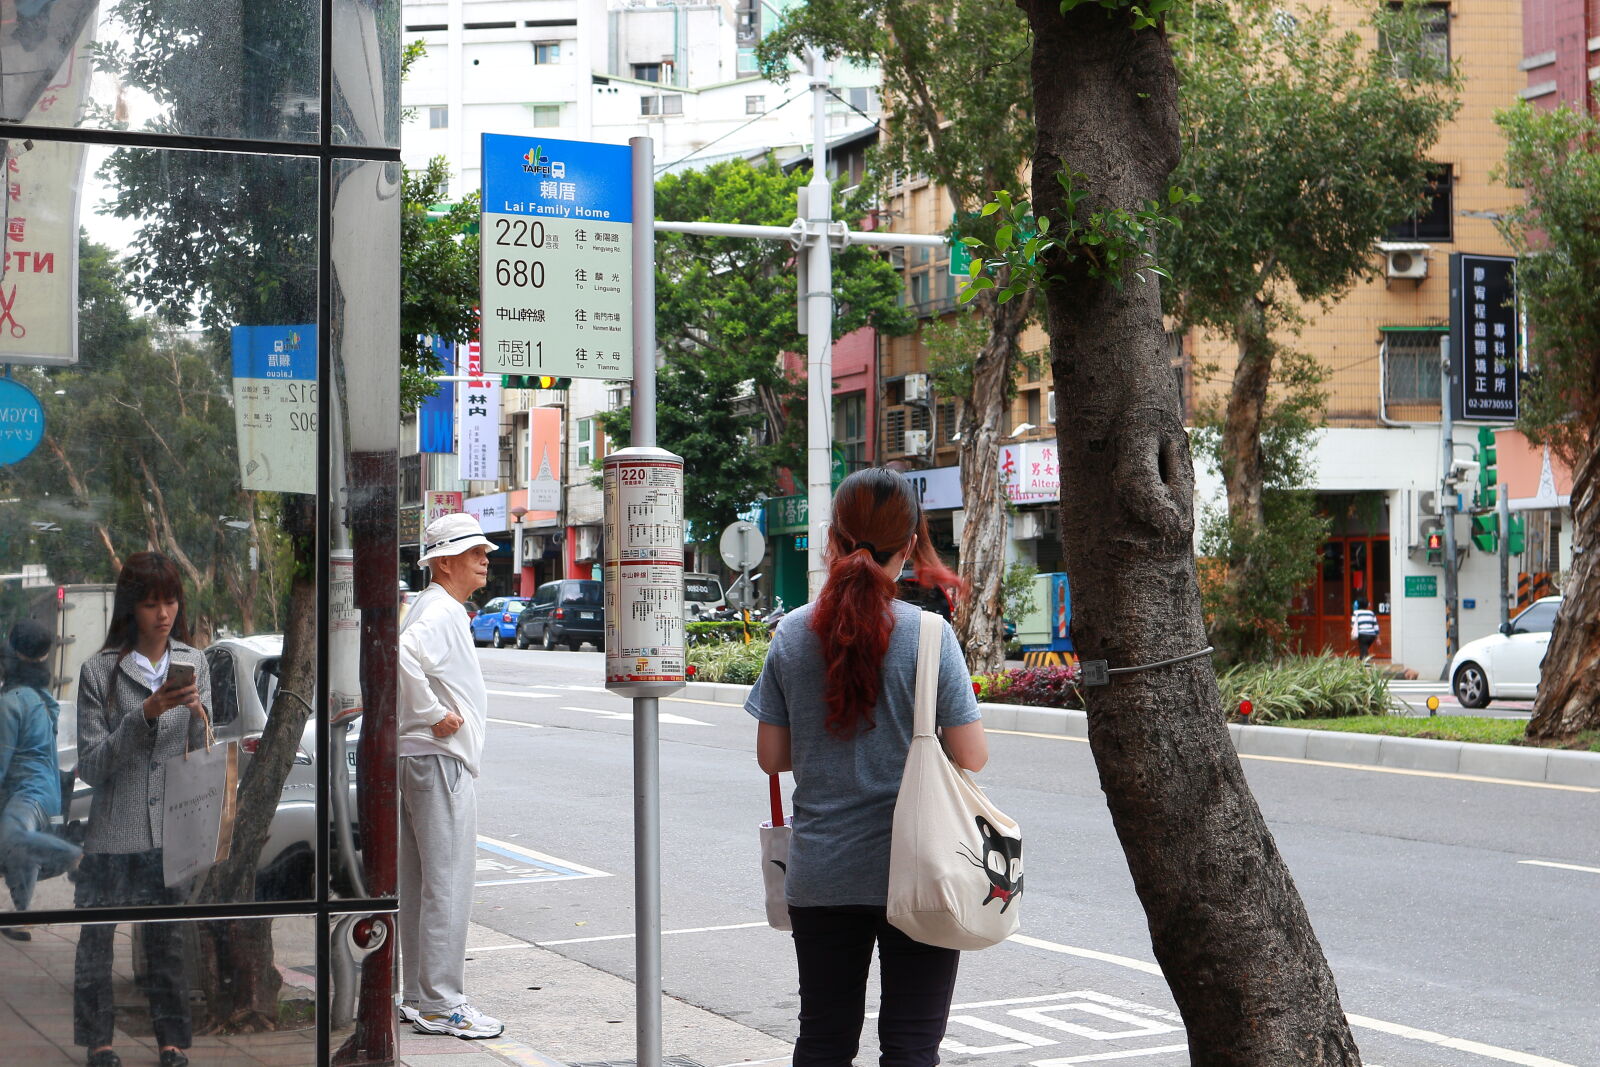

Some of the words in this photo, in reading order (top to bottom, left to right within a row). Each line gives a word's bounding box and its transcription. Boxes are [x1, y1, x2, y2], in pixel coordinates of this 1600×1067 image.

[522, 164, 550, 174] TAIPEI
[540, 181, 576, 201] 賴厝
[505, 201, 524, 212] Lai
[529, 203, 570, 217] Family
[575, 206, 610, 218] Home
[495, 219, 544, 248] 220
[575, 229, 587, 242] 往
[594, 232, 619, 243] 衡陽路
[592, 245, 613, 253] Hengyang
[496, 259, 544, 289] 680
[575, 268, 587, 282] 往
[594, 285, 620, 293] Linguang
[496, 307, 546, 323] 中山幹線
[575, 309, 587, 322] 往
[593, 312, 620, 322] 南門市場
[498, 340, 524, 354] 市民
[498, 354, 524, 367] 小巴
[575, 348, 587, 361] 往
[595, 351, 620, 361] 天母
[597, 363, 619, 371] Tianmu
[1468, 398, 1513, 409] 02-28730555
[622, 469, 645, 480] 220
[434, 494, 455, 506] 茉莉
[622, 571, 646, 580] 中山幹線
